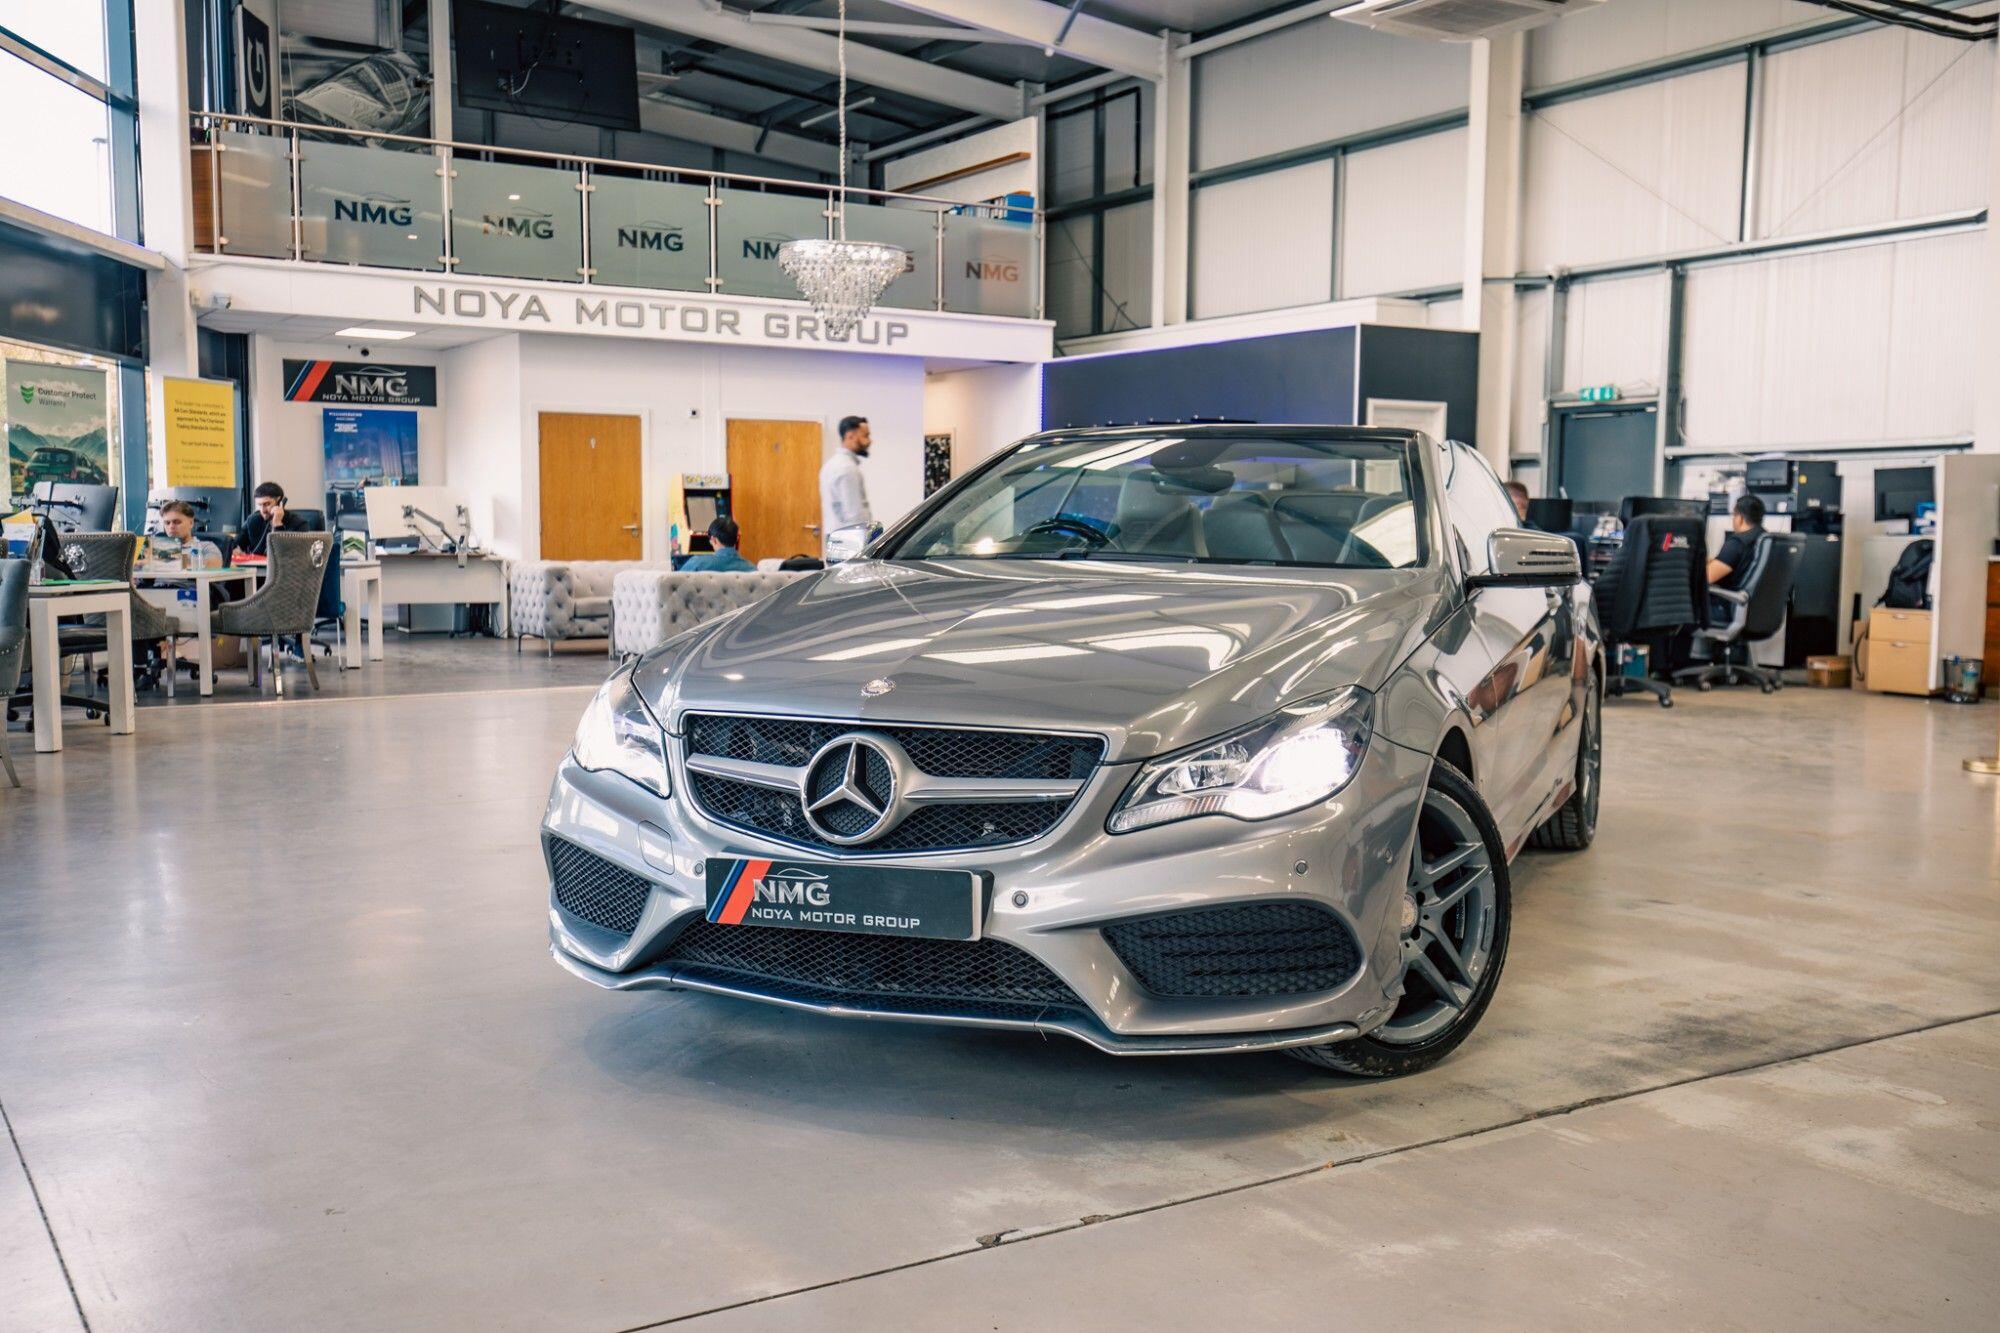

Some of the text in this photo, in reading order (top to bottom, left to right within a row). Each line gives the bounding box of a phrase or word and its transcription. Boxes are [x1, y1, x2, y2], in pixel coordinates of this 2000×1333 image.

[334, 199, 412, 226] NMG
[618, 228, 684, 252] NMG
[743, 239, 782, 261] NM
[965, 261, 1019, 283] NMG
[413, 285, 551, 322] NOYA
[576, 298, 742, 336] MOTOR
[37, 387, 97, 400] Customer Protect
[335, 374, 408, 397] NMG
[322, 392, 421, 404] NOYA MOTOR GROUP
[752, 878, 831, 906] NMG
[751, 907, 921, 929] NOYA MOTOR GROUP
